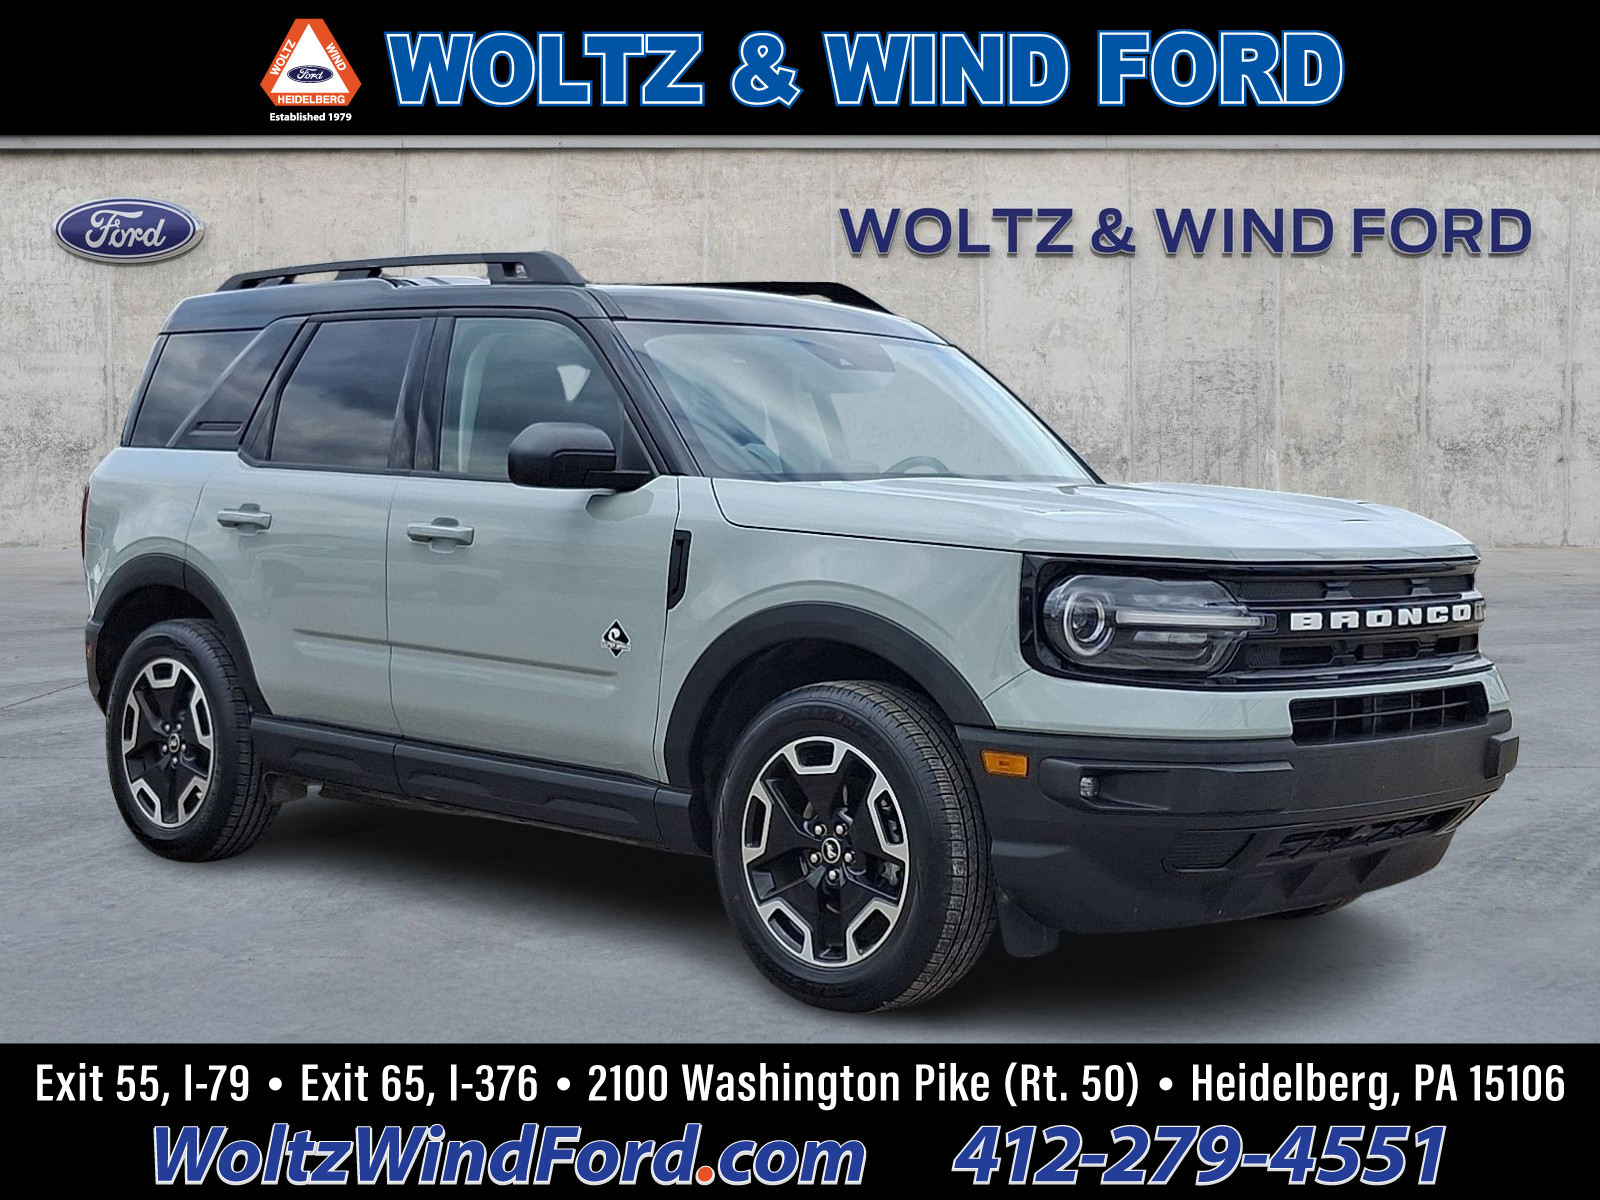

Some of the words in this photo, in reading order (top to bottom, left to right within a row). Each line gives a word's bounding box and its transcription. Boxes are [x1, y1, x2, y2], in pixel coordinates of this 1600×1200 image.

[86, 209, 167, 249] Ford
[840, 208, 1074, 255] WOLTZ
[1091, 207, 1136, 255] &
[1156, 208, 1335, 255] WIND
[1353, 208, 1533, 255] FORD
[1290, 603, 1473, 632] BRONCO
